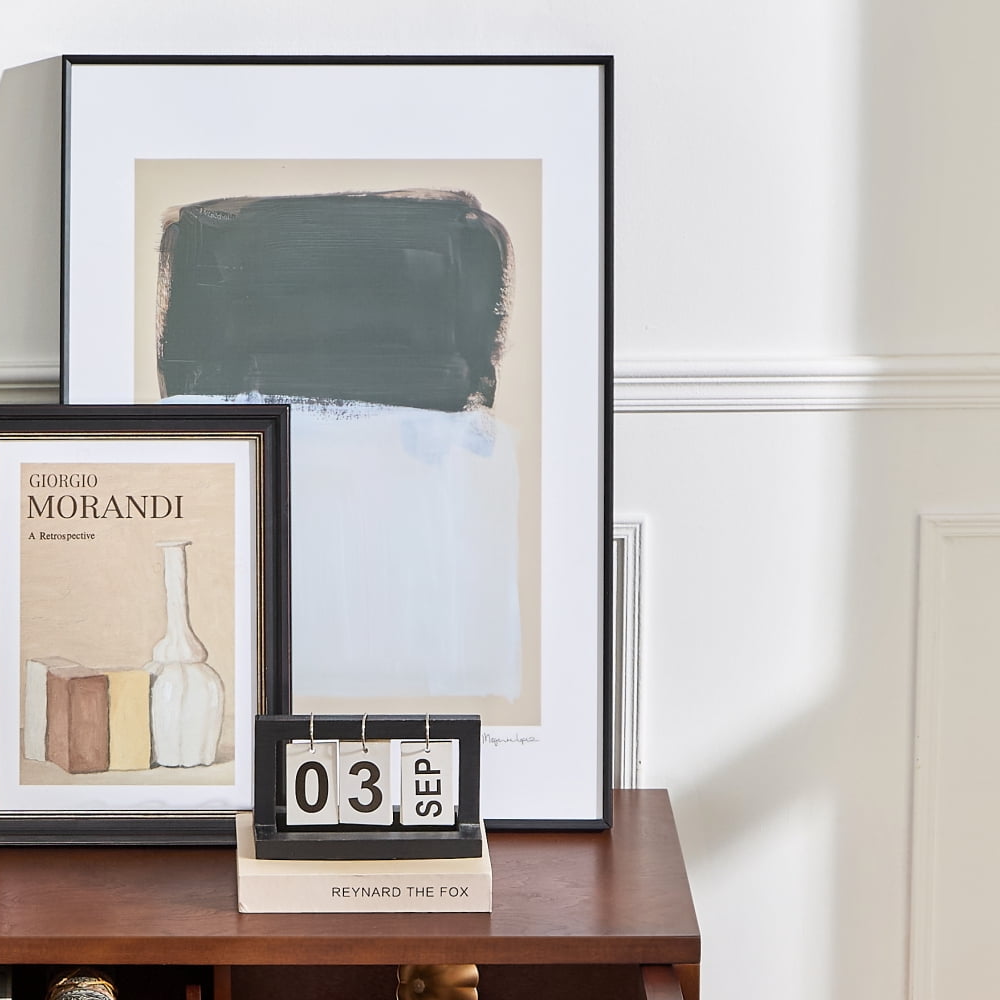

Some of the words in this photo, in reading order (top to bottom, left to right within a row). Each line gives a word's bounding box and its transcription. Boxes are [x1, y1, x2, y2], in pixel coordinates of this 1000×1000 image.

[29, 474, 98, 488] GIORGIO
[26, 494, 184, 519] MORANDI
[28, 532, 36, 540] A
[39, 532, 96, 541] Retrospective
[414, 758, 443, 818] SEP
[331, 886, 402, 898] REYNARD
[406, 886, 434, 898] THE
[440, 886, 469, 898] FOX
